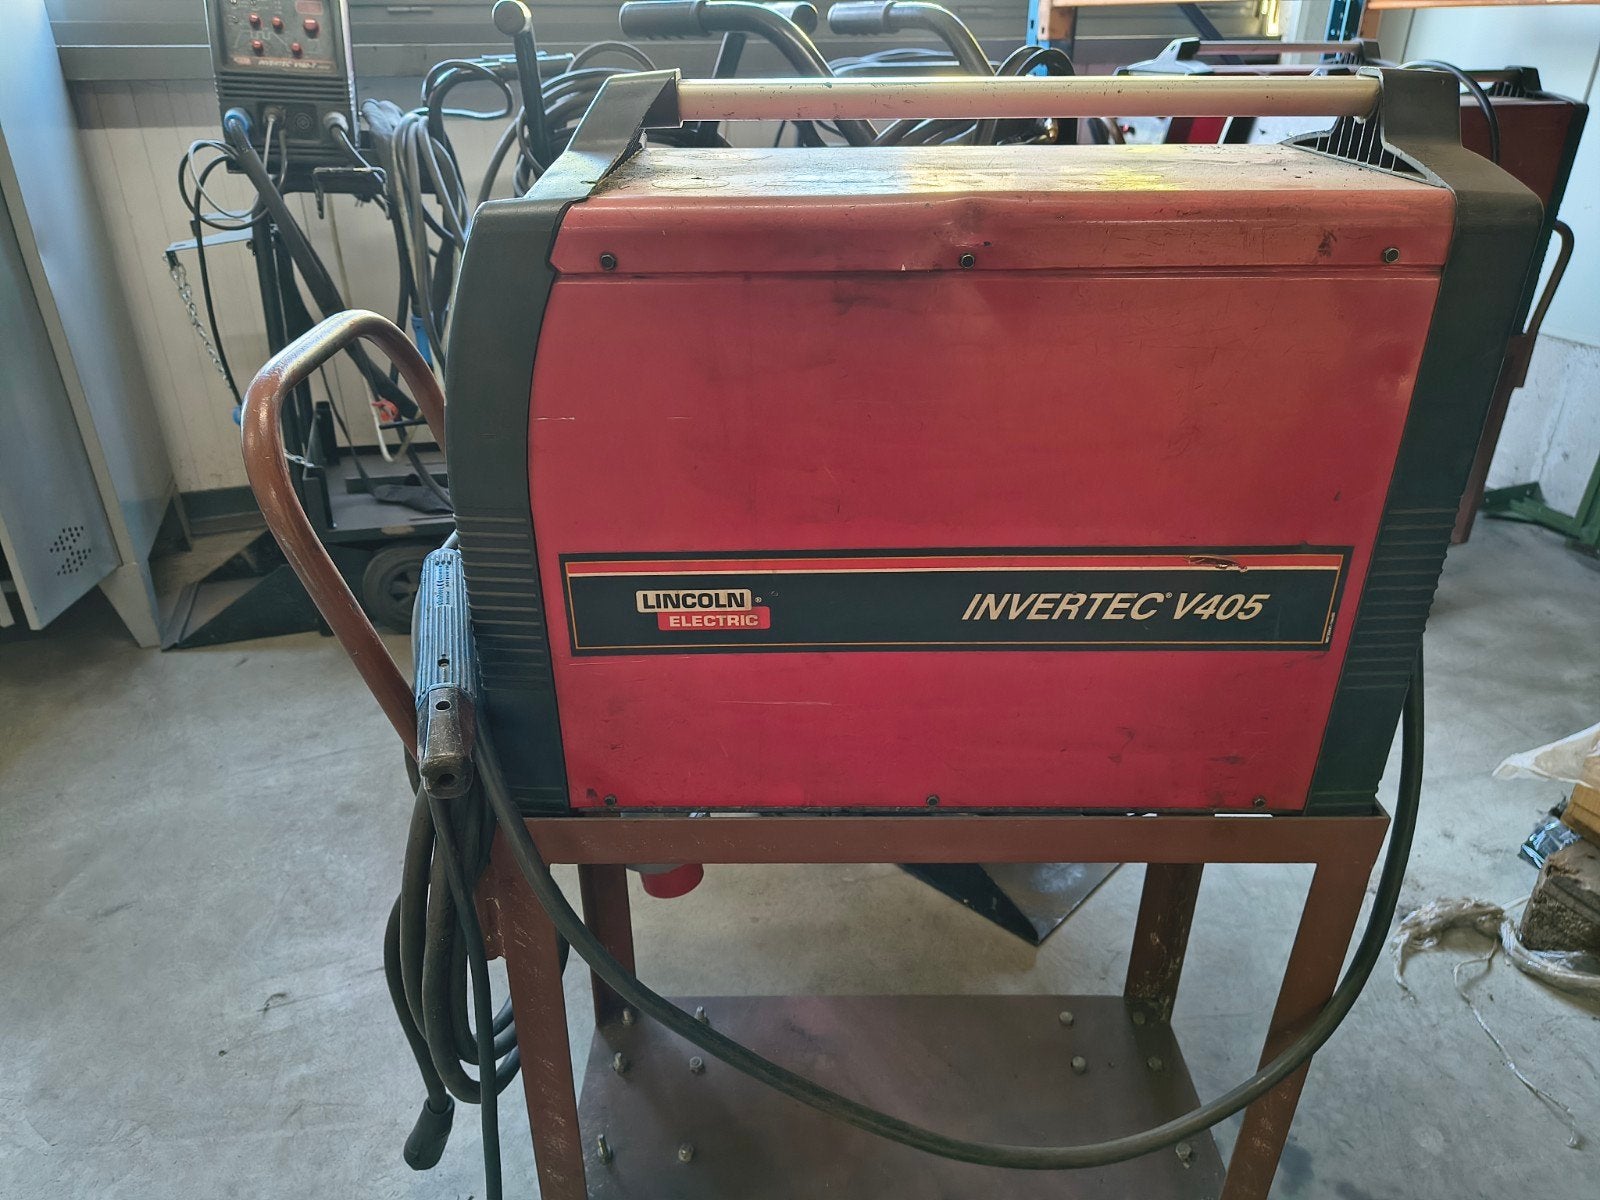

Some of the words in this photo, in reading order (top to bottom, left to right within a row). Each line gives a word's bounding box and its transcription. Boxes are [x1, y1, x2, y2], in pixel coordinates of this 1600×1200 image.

[642, 592, 745, 609] LINCOLN
[1172, 593, 1271, 621] V405
[669, 614, 759, 627] ELECTRIC
